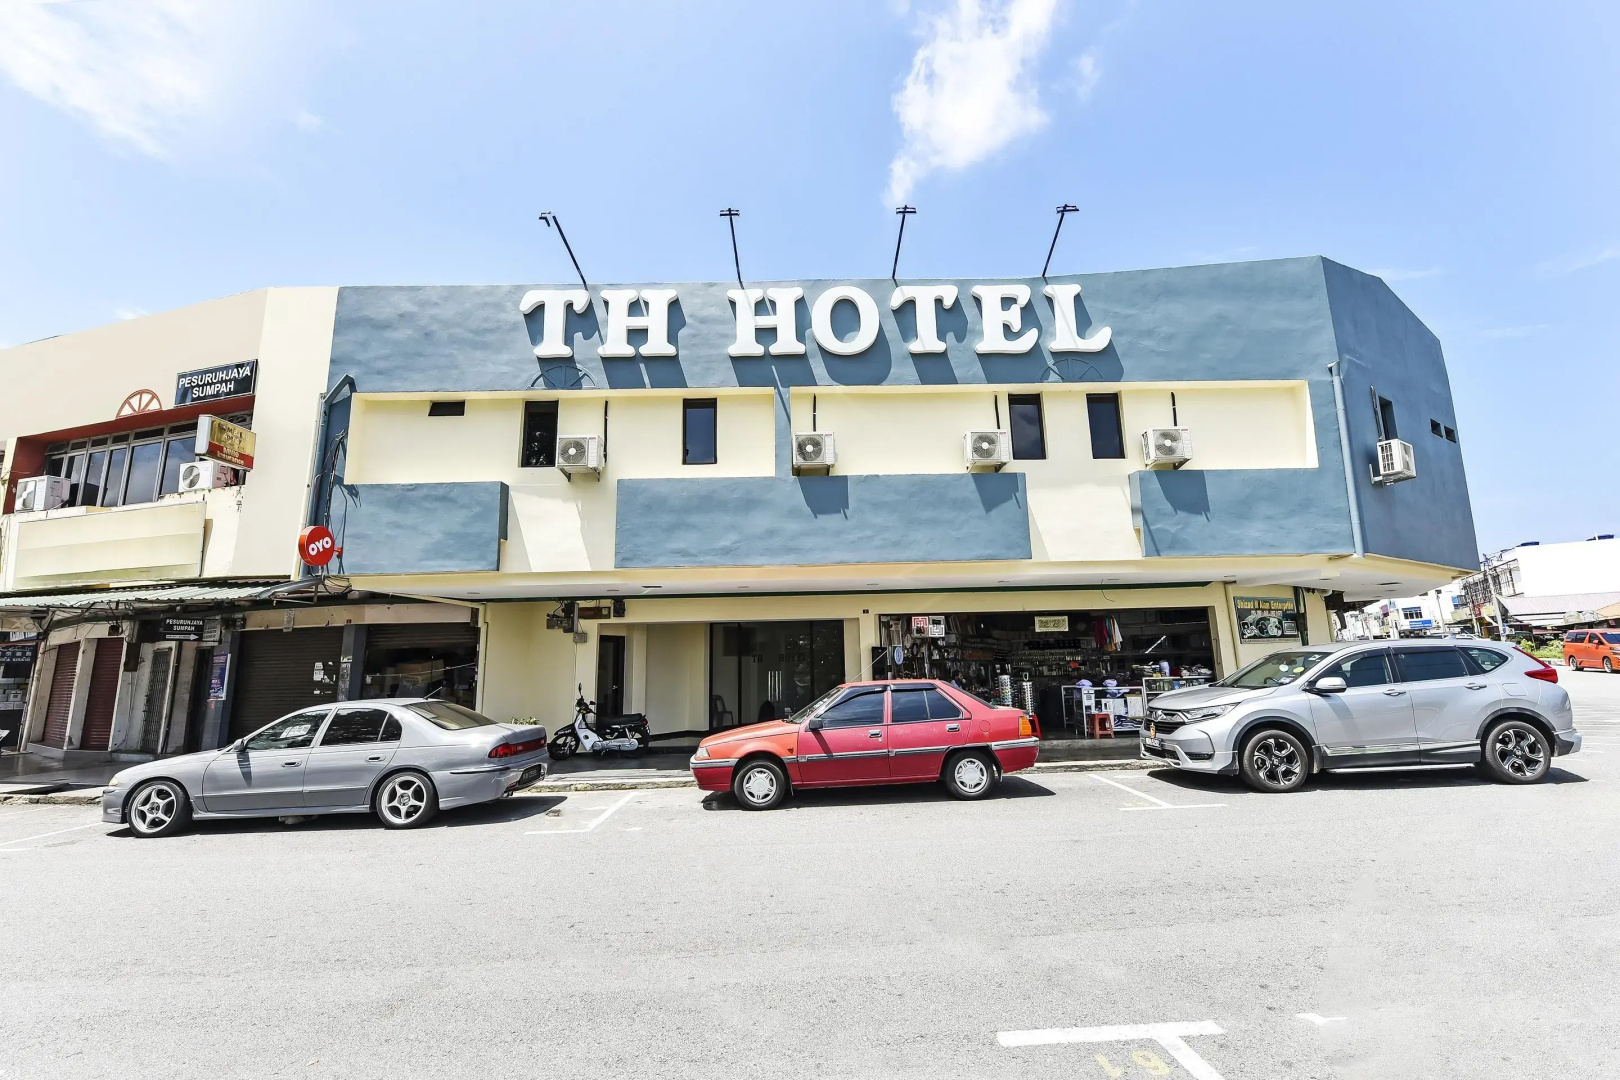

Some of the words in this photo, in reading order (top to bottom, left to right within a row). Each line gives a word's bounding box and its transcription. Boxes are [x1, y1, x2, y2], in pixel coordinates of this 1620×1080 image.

[519, 289, 678, 358] TH
[726, 284, 1112, 357] HOTEL
[178, 366, 251, 388] PESURUHJAYA
[192, 381, 235, 398] SUMPAH
[308, 536, 332, 556] OYO
[1271, 600, 1294, 611] Enterprise
